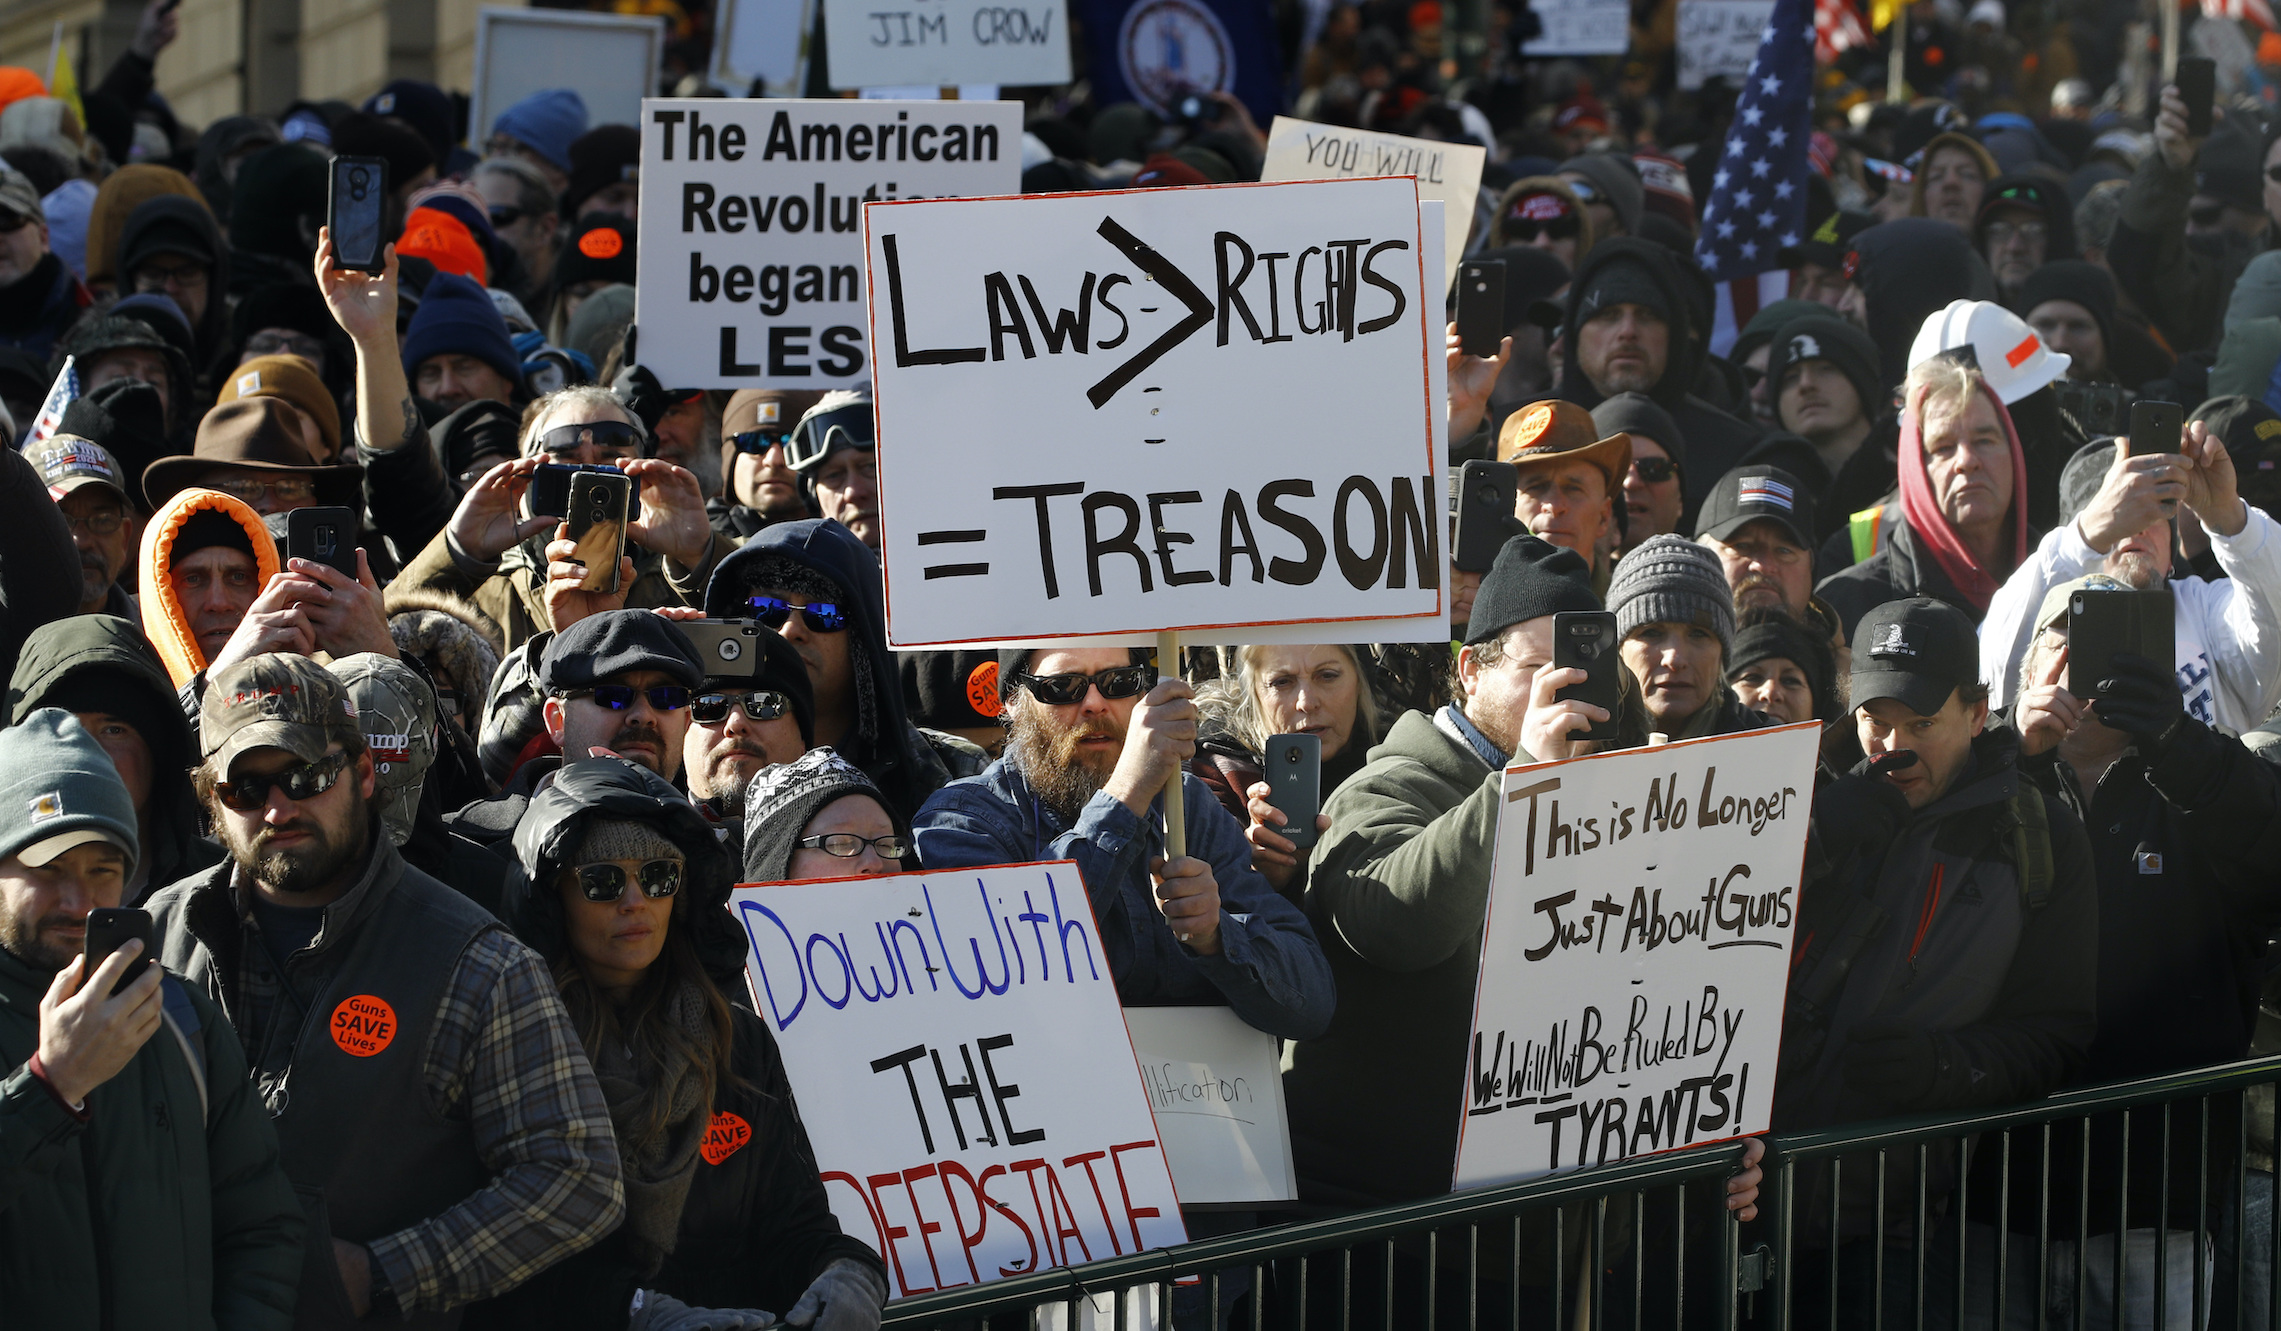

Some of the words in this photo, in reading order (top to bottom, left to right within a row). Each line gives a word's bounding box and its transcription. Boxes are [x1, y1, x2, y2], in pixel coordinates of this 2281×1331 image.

[869, 12, 948, 47] JIM
[972, 7, 1053, 46] CROW
[654, 111, 746, 161] The
[762, 111, 999, 161] American
[1306, 133, 1359, 172] YOU
[1376, 146, 1443, 183] WILL
[682, 182, 960, 233] Revolu
[688, 252, 859, 316] began
[882, 233, 1132, 368] LAWS
[1215, 231, 1409, 347] RIGHTS
[719, 326, 864, 377] LES
[993, 475, 1440, 600] TREASON
[223, 684, 300, 709] TRUMP
[970, 664, 996, 686] Guns
[972, 676, 999, 706] SAV
[984, 699, 1001, 713] Liv
[362, 733, 410, 755] ump
[1508, 777, 1601, 877] This
[1609, 801, 1636, 845] is
[1643, 772, 1688, 834] No
[1697, 766, 1796, 836] Longer
[1524, 889, 1624, 962] Just
[1620, 877, 1717, 953] About
[1715, 864, 1792, 937] Guns
[740, 900, 938, 1032] Down
[922, 871, 1100, 1000] With
[334, 1011, 391, 1039] SAVE
[349, 998, 388, 1018] Guns
[338, 1030, 377, 1051] Lives
[1473, 1030, 1505, 1107] We
[1574, 1006, 1617, 1088] Be
[1620, 995, 1690, 1073] Ruled
[1693, 985, 1744, 1080] By
[869, 1033, 1046, 1155] THE
[1142, 1062, 1254, 1108] llification
[710, 1116, 737, 1127] uns
[1534, 1063, 1749, 1170] TYRANTS!
[708, 1142, 742, 1159] Lives
